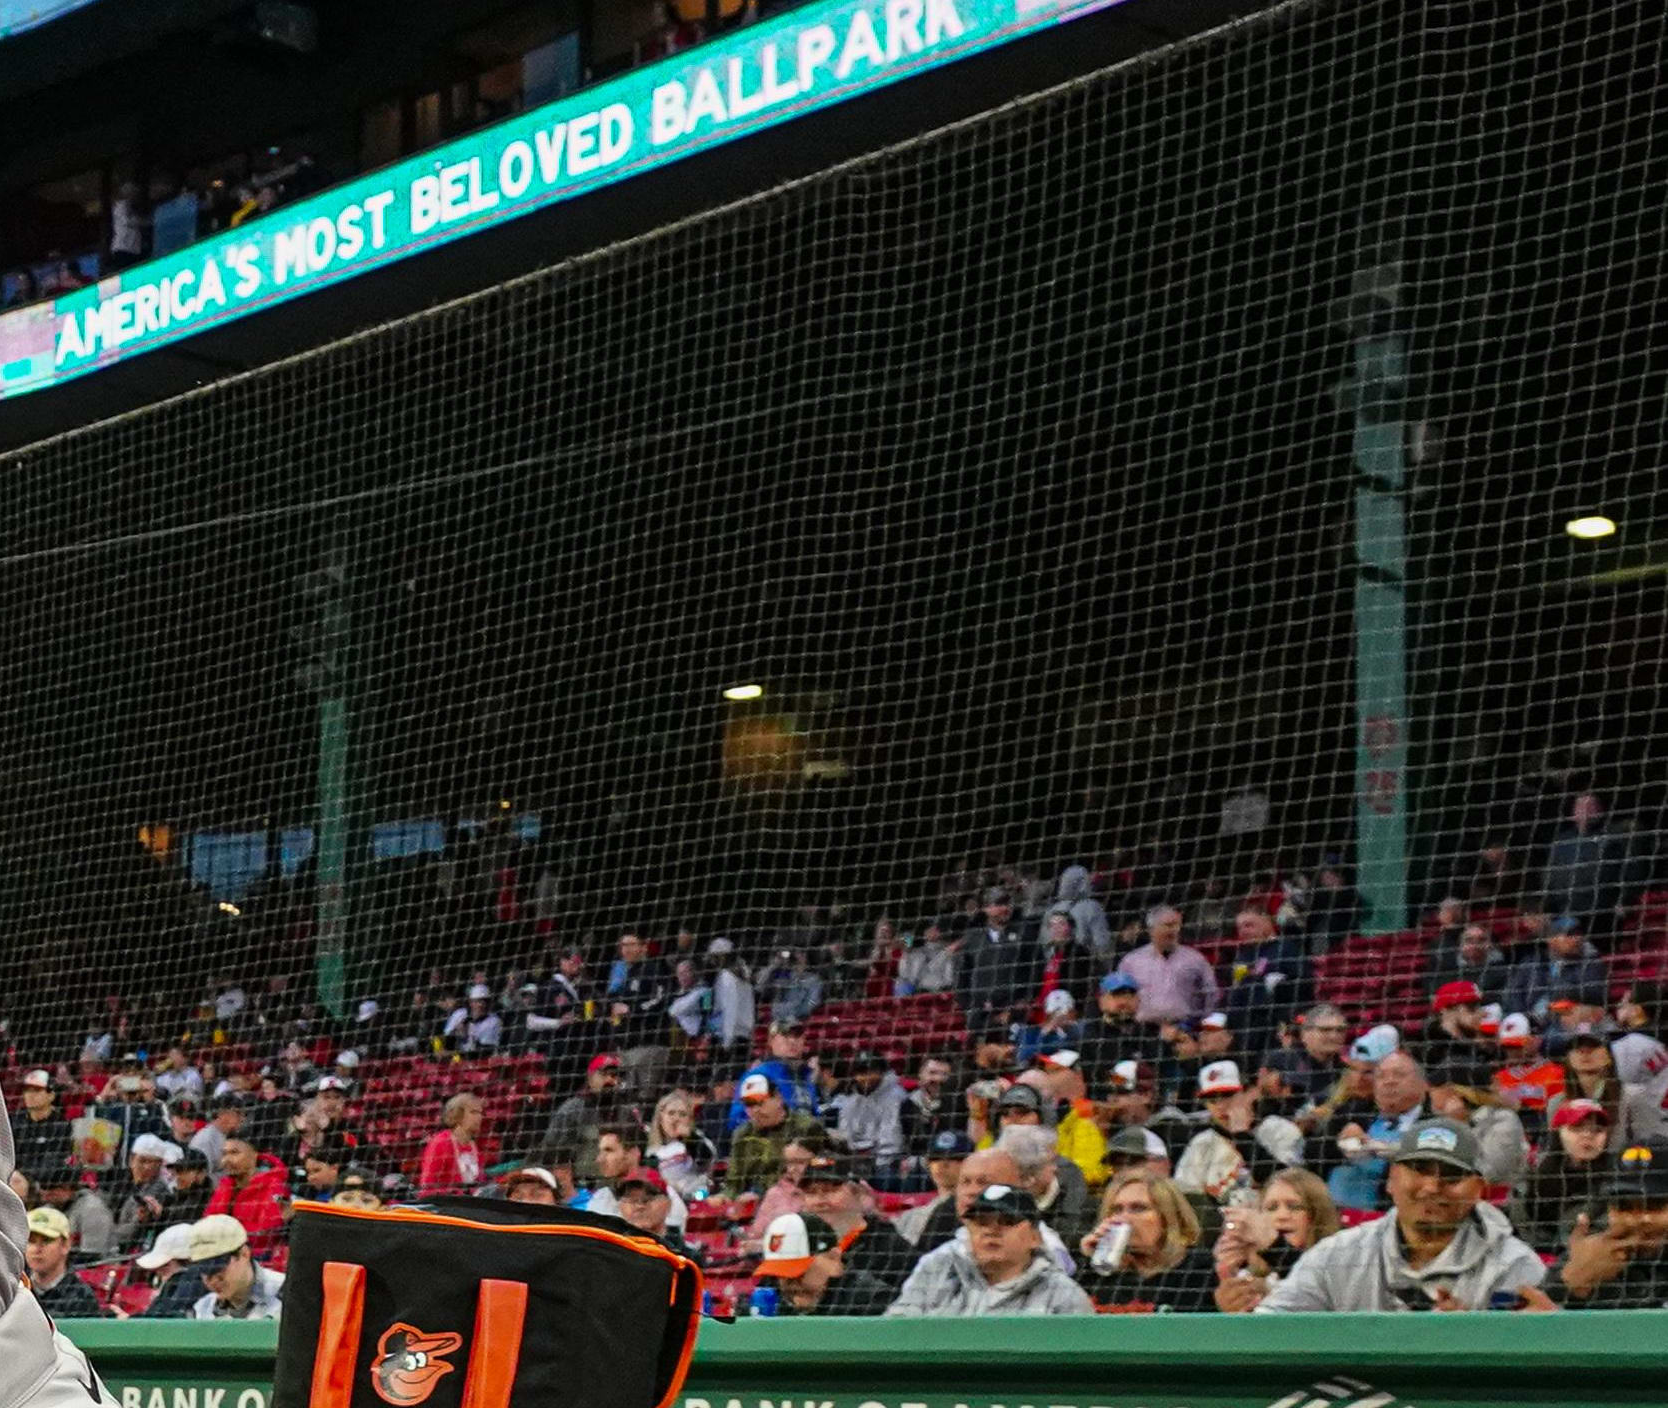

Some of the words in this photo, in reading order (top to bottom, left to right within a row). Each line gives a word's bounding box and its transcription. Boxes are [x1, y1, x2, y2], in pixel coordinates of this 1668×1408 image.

[54, 243, 263, 367] AMERICA'S
[273, 188, 396, 286] MOST
[409, 101, 634, 235] BELOVED
[651, 0, 967, 146] BALLPARK
